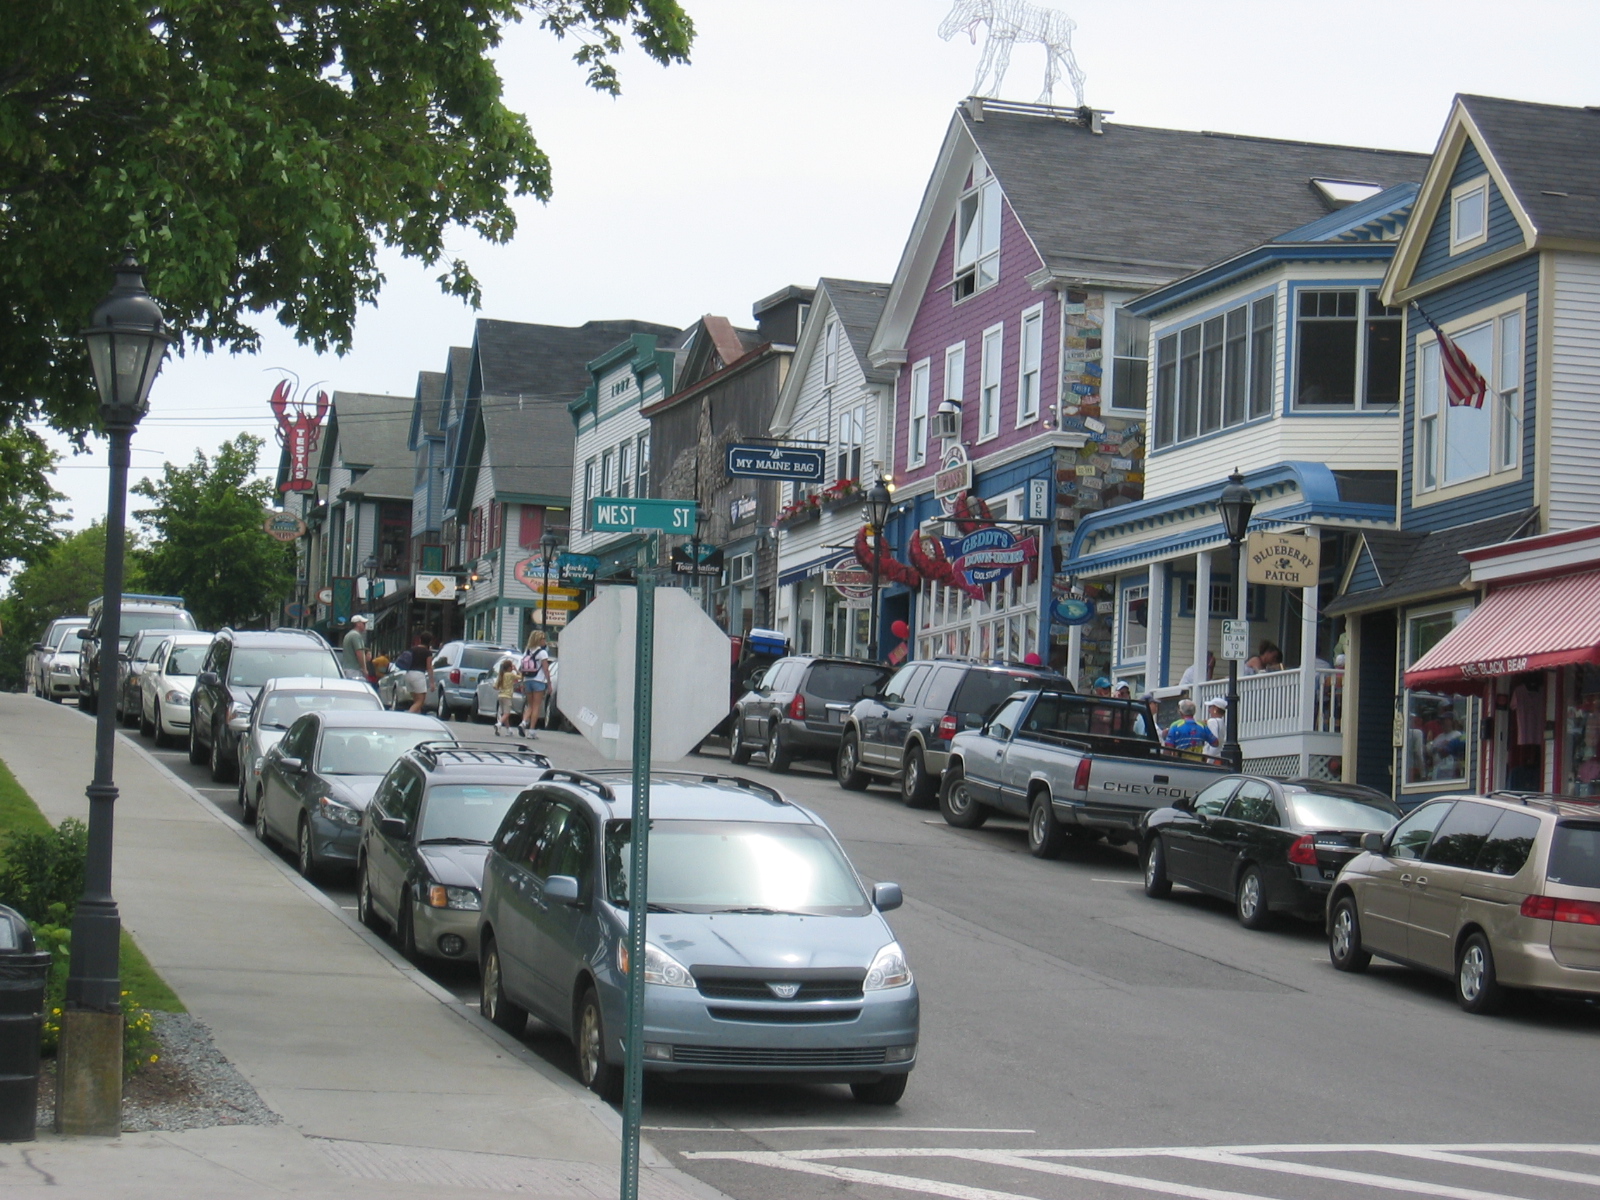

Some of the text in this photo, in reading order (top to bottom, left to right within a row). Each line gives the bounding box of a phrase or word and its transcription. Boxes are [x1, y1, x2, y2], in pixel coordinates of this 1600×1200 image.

[296, 429, 306, 479] TESTA'S
[736, 458, 815, 473] MY MAINE BAG
[597, 505, 690, 528] WEST ST
[962, 531, 1009, 554] GEDDY'S
[1252, 545, 1314, 569] BLUEBERRY
[562, 563, 588, 572] Jack's
[675, 561, 720, 572] Touraline
[527, 571, 560, 579] LANING
[1265, 570, 1300, 582] PATCH
[1224, 622, 1230, 633] 2
[1460, 657, 1528, 677] THE BLACK BEAR
[1103, 781, 1199, 799] CHEVROL
